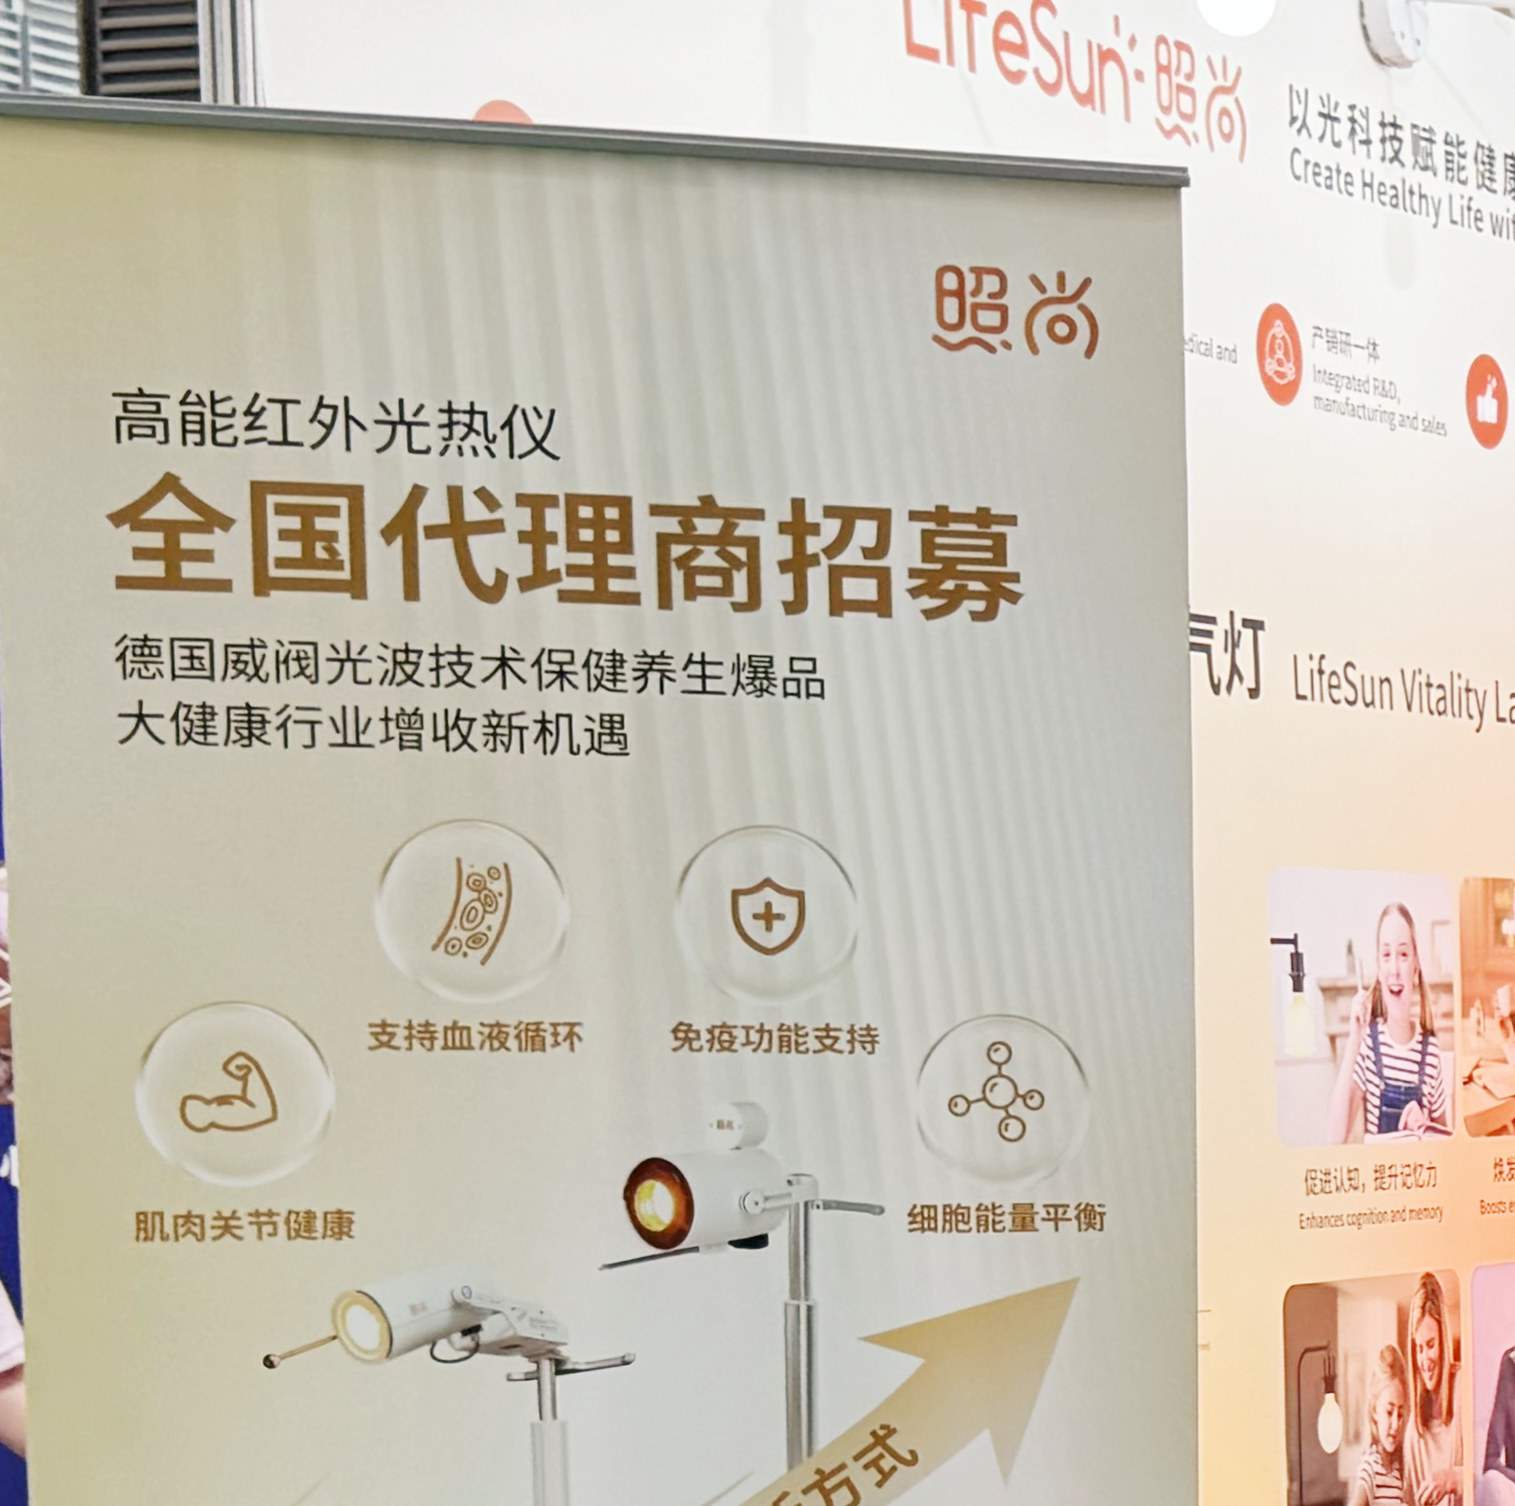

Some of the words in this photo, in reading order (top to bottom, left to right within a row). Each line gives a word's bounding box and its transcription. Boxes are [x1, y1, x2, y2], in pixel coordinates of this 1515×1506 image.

[1155, 34, 1247, 164] 照尚
[1290, 148, 1354, 197] Create
[1361, 169, 1441, 229] Healthy
[1449, 193, 1483, 232] Life
[933, 262, 1101, 361] 照尚
[1216, 344, 1238, 364] and
[1312, 325, 1380, 362] 产销研一体
[1313, 364, 1370, 394] Integrated
[110, 387, 563, 463] 高能红外光热仪
[1313, 394, 1397, 432] manufacturing
[1398, 411, 1419, 430] and
[1421, 415, 1447, 437] sales
[105, 471, 1024, 624] 全国代理商招募
[114, 633, 827, 701] 德国威阀光波技术保健养生爆品
[1293, 654, 1393, 711] LifeSun
[1400, 667, 1487, 733] Vitality
[116, 701, 632, 758] 大健康行业增收新机遇
[366, 1019, 584, 1055] 支持血液循环
[670, 1020, 880, 1058] 免疫功能支持
[1304, 1161, 1437, 1196] 促进认知，提升记忆力
[134, 1208, 356, 1243] 肌肉关节健康
[907, 1202, 1107, 1236] 细胞能量平衡
[1300, 1212, 1345, 1230] Enhances
[1347, 1208, 1389, 1230] cognition
[1391, 1206, 1407, 1224] and
[1408, 1206, 1444, 1224] memory
[1480, 1199, 1506, 1215] Boosts
